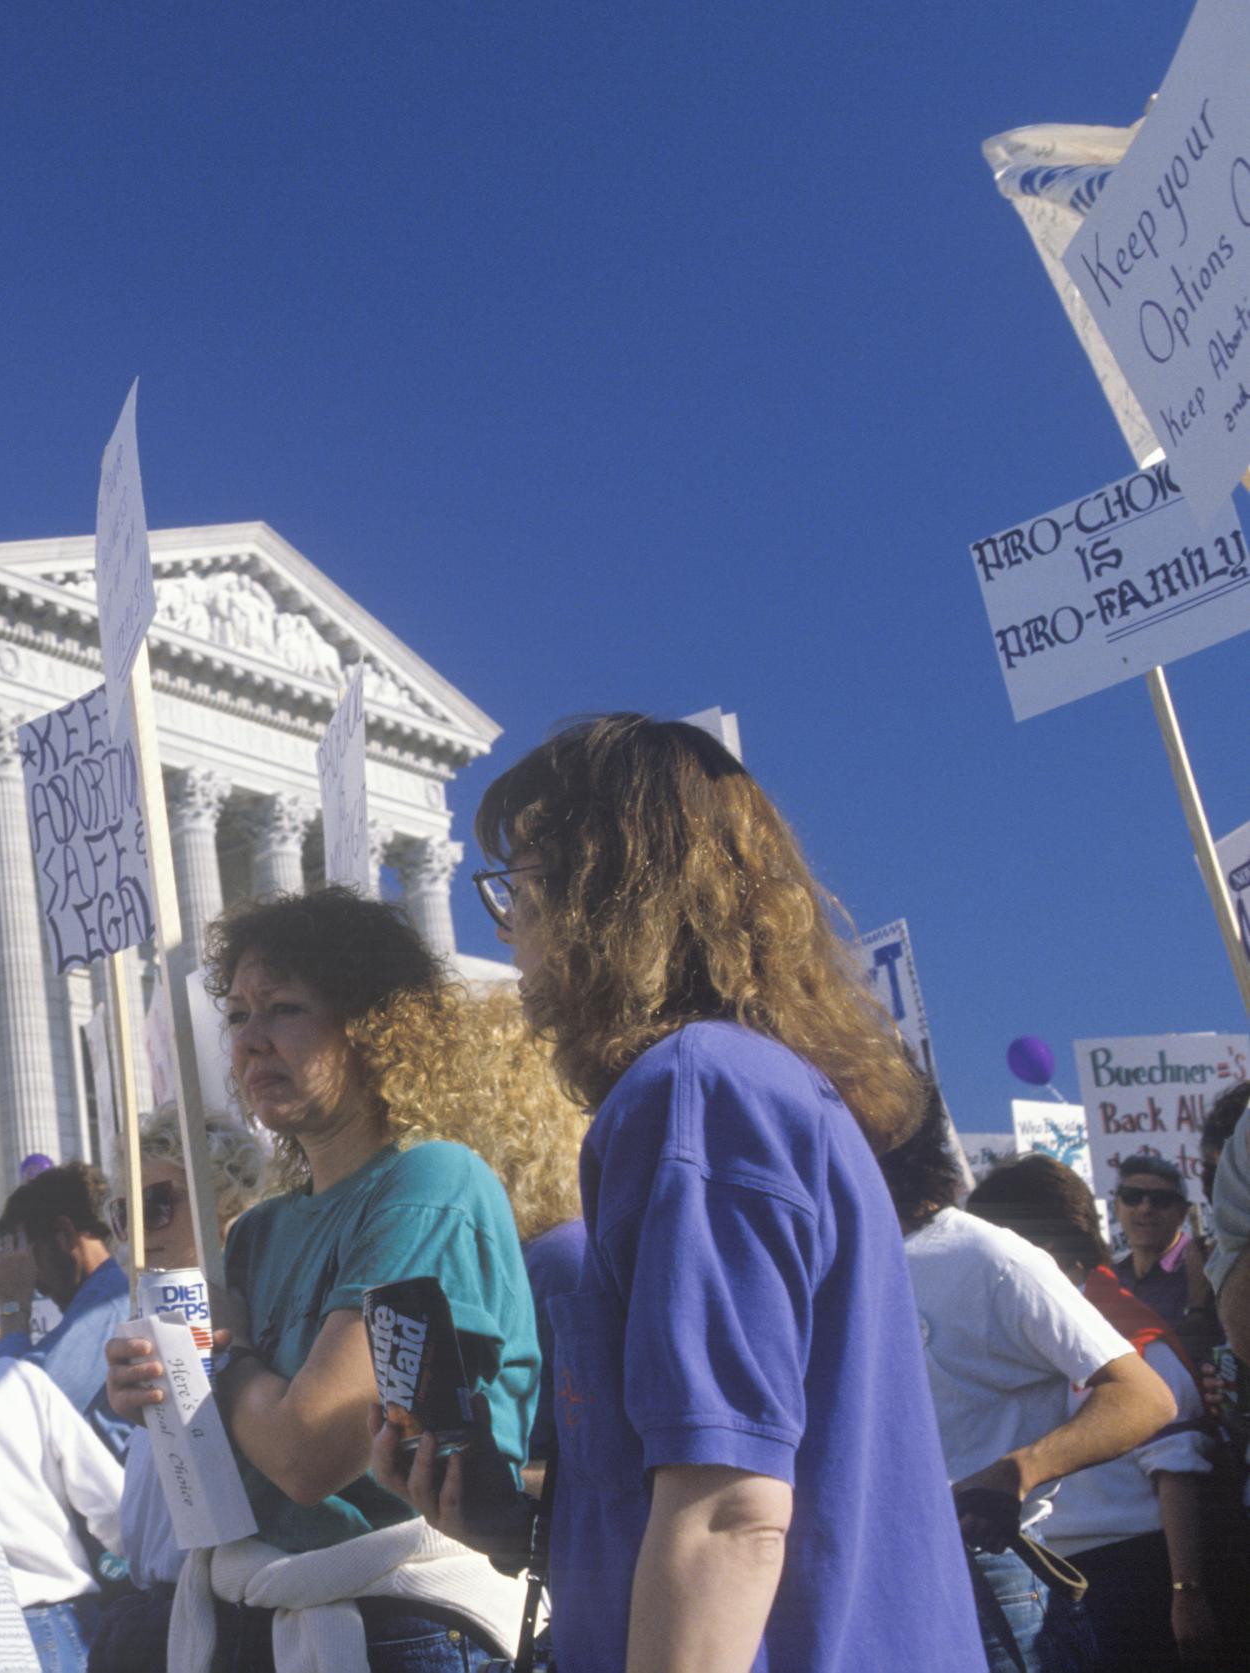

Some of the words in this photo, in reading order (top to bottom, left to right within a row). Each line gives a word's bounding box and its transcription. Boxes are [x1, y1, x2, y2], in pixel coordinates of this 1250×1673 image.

[1082, 210, 1159, 307] Keep
[1161, 98, 1215, 247] your
[1139, 234, 1234, 364] Options
[1160, 387, 1205, 447] Keep
[1075, 537, 1123, 583] IS
[996, 529, 1249, 669] PRO-FAMILY
[27, 688, 109, 776] KEE
[44, 818, 132, 915] SAFE
[48, 876, 155, 975] LEGAL
[1099, 1097, 1166, 1134] Back
[1177, 1094, 1206, 1134] All
[162, 1283, 203, 1303] DIET
[167, 1358, 195, 1411] Here's
[168, 1453, 194, 1507] Choice
